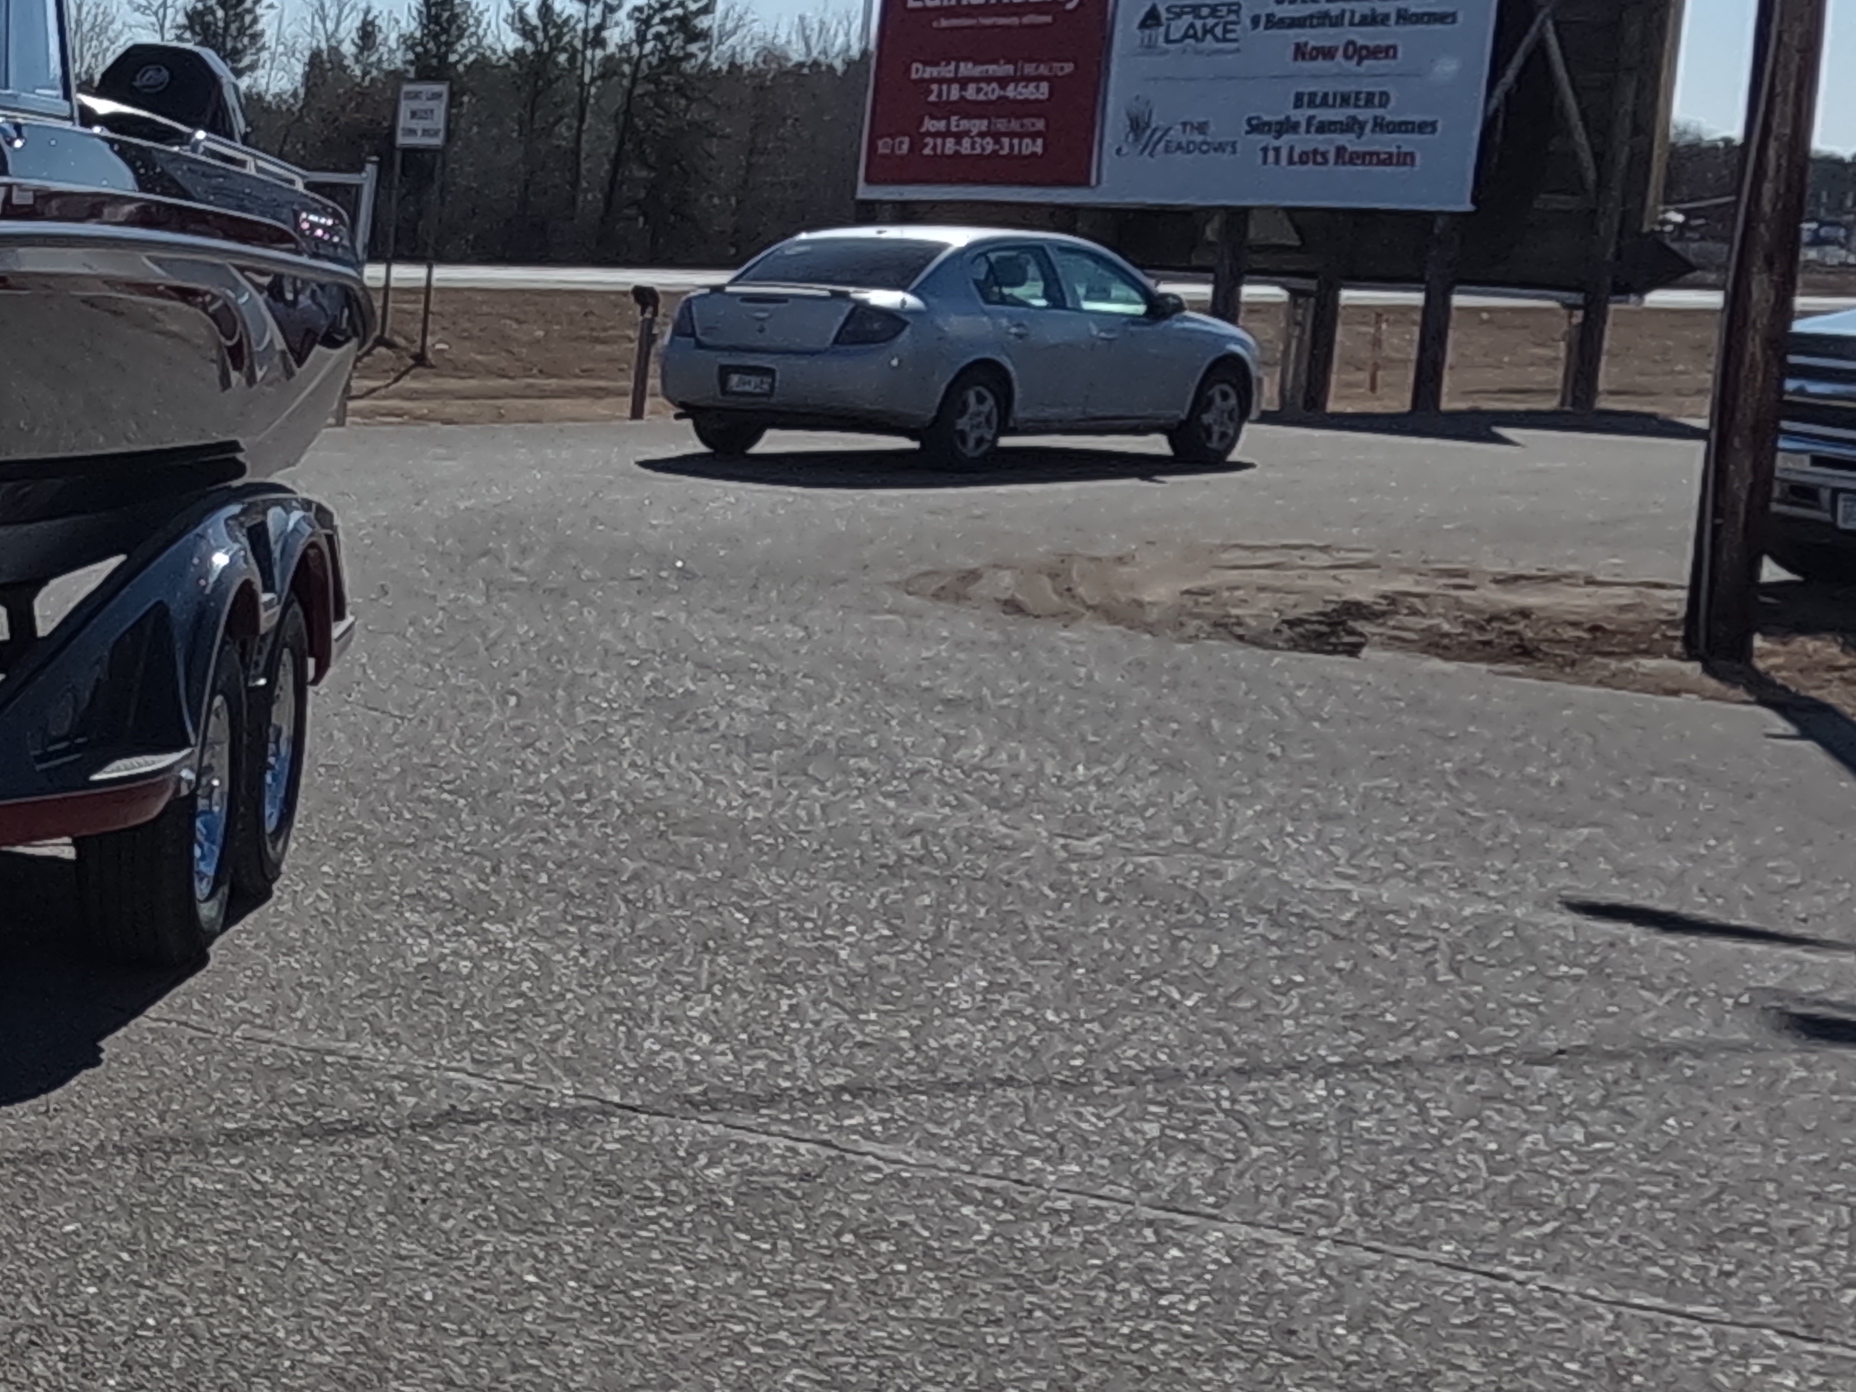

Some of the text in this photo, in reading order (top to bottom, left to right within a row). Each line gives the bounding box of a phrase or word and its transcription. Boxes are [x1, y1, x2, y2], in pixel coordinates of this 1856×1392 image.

[1164, 2, 1242, 22] SPIDER
[1263, 9, 1345, 31] Beautiful
[1350, 9, 1391, 28] Lake
[1394, 7, 1457, 26] Homes
[1163, 20, 1240, 44] LAKE
[1293, 39, 1399, 67] Now Open
[910, 62, 955, 79] David
[1293, 90, 1392, 110] BRAINERD
[1180, 120, 1210, 135] THE
[1245, 114, 1439, 140] Single Family Homes
[1259, 145, 1417, 167] 11 Lots Remain
